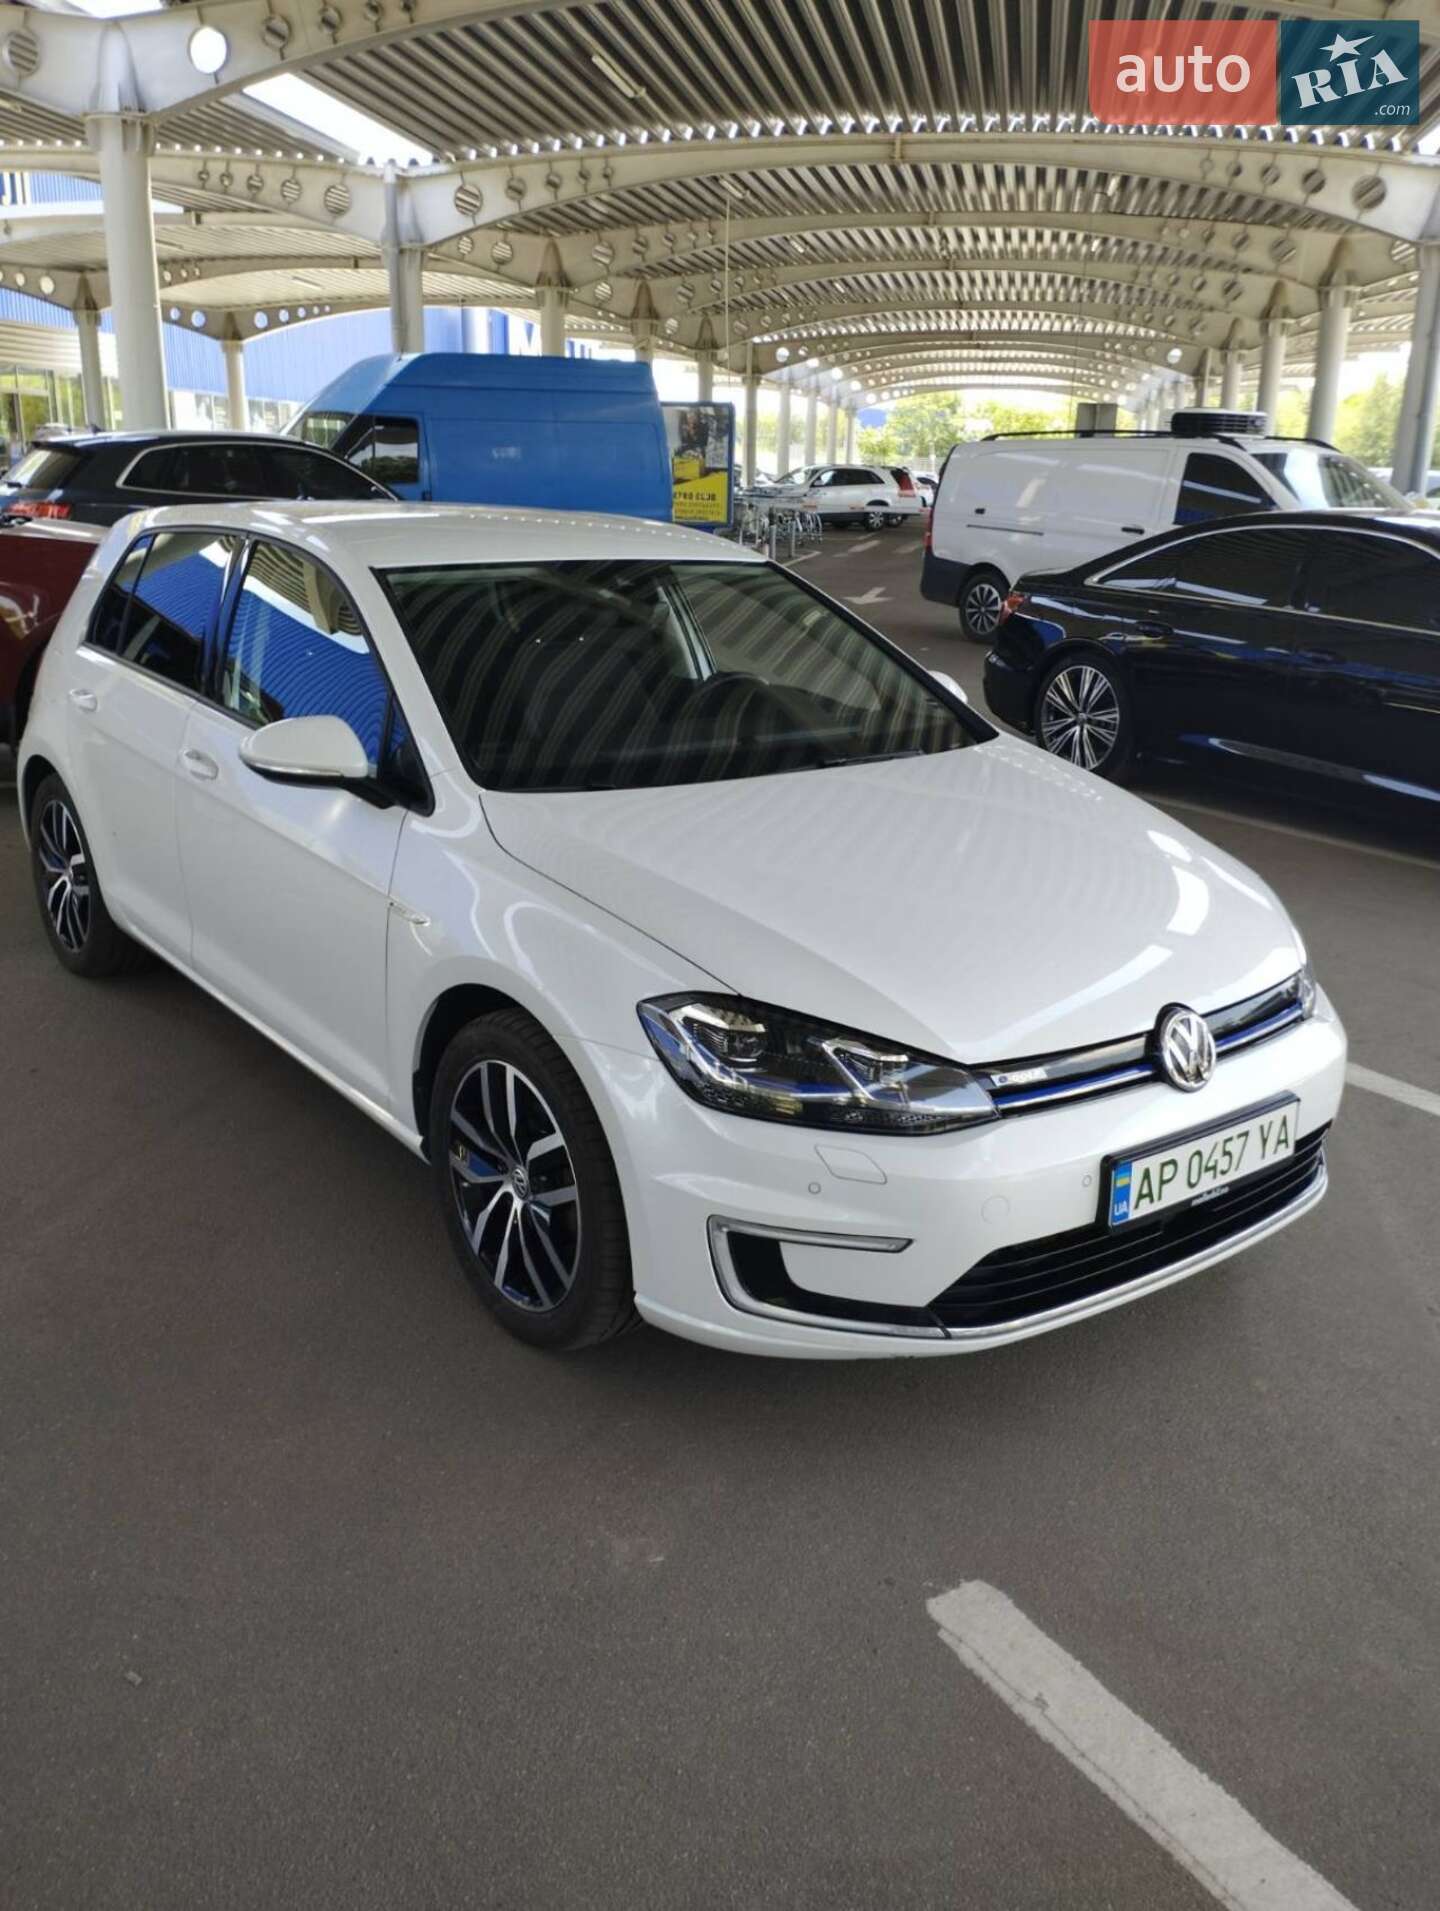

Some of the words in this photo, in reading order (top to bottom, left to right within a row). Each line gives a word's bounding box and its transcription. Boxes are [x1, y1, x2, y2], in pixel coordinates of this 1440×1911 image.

[1134, 1159, 1178, 1210] AP
[1186, 1131, 1250, 1189] 0457
[1259, 1115, 1289, 1160] YA
[1114, 1201, 1128, 1216] UA
